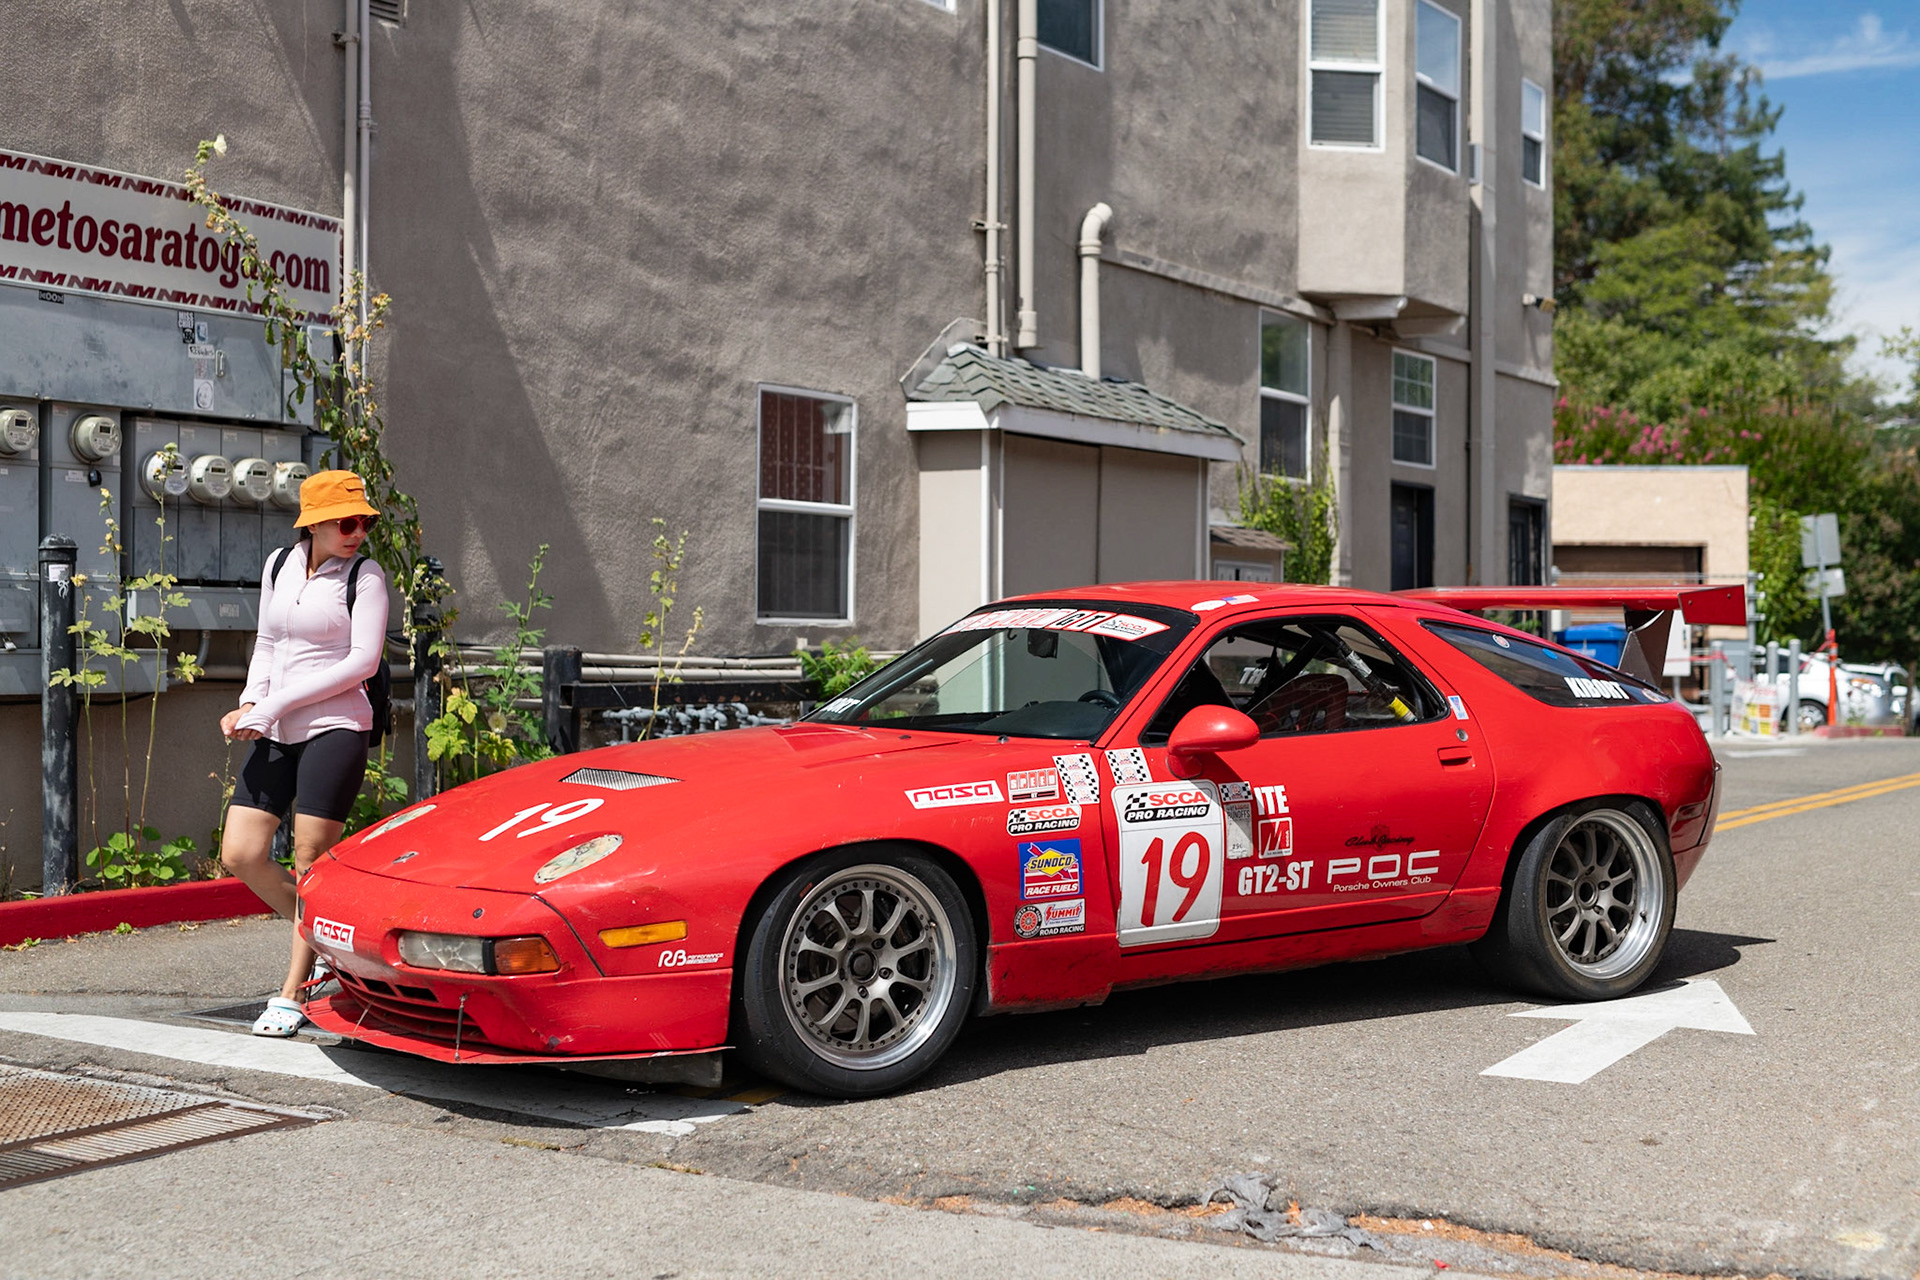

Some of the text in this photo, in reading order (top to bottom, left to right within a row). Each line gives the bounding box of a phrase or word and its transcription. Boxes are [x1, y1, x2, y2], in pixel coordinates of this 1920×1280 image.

[0, 154, 27, 170] M
[1564, 677, 1630, 700] KIBORT
[913, 783, 993, 802] nasa
[1149, 791, 1208, 806] SCCA
[1254, 785, 1290, 816] ITE
[478, 798, 604, 842] 19
[1027, 807, 1078, 821] SCCA
[1126, 806, 1208, 821] PRO RACING
[1010, 817, 1078, 833] PRO RACING
[1030, 856, 1072, 870] SUNOCO
[1326, 849, 1441, 884] POC
[1141, 831, 1211, 928] 19
[1238, 860, 1314, 896] GT2-ST
[1333, 875, 1432, 893] Porsche Owners Club
[1026, 883, 1078, 896] RACE FUELS
[315, 920, 351, 943] nasa
[1039, 925, 1084, 936] ROAD RACING
